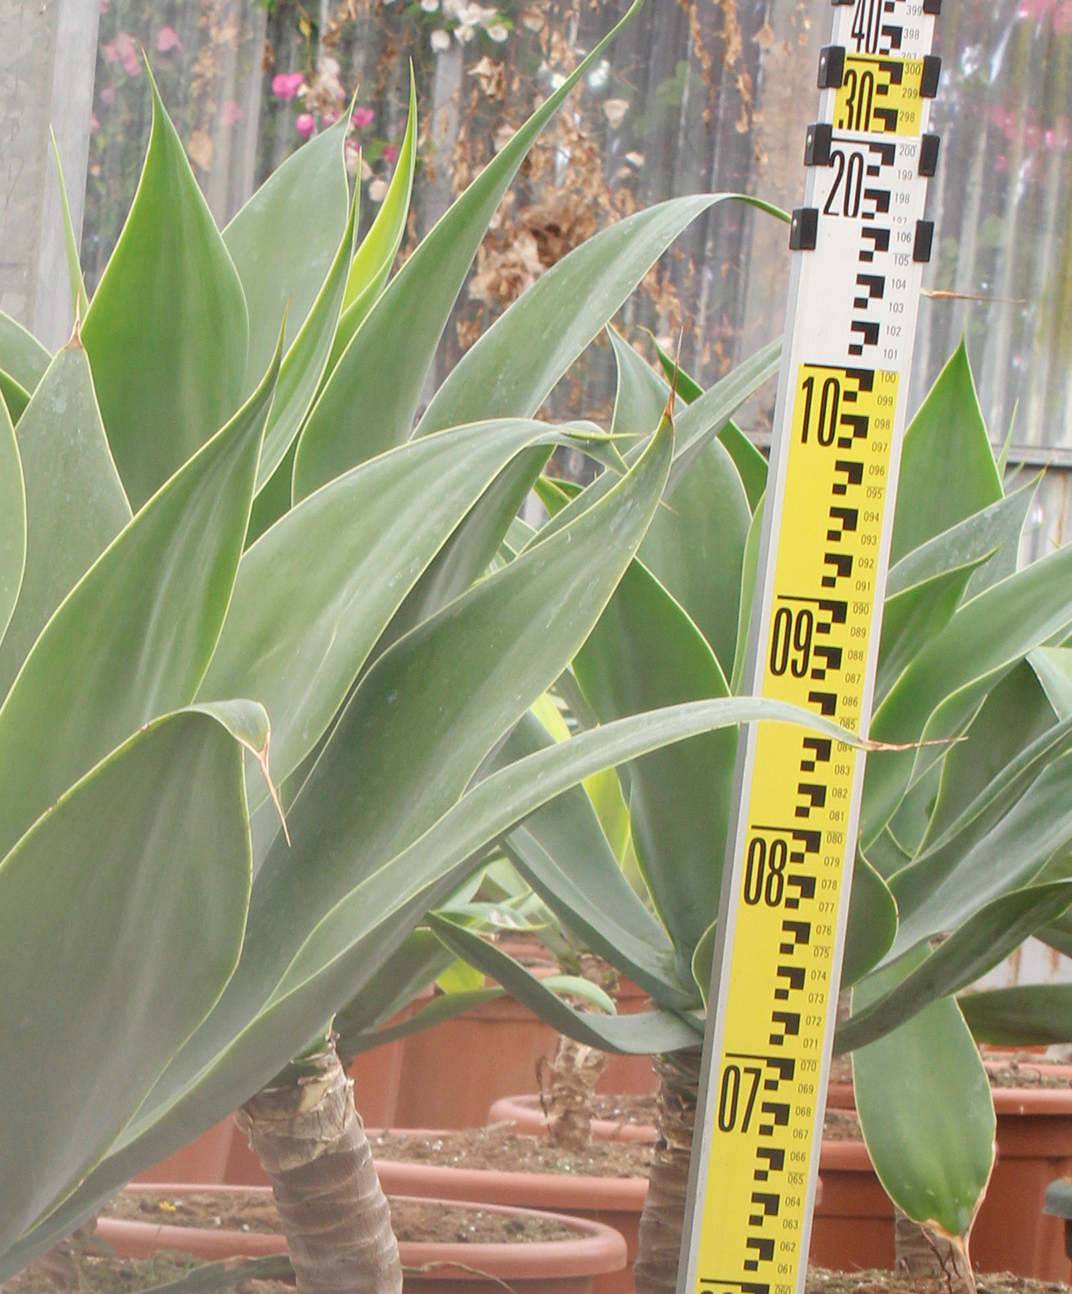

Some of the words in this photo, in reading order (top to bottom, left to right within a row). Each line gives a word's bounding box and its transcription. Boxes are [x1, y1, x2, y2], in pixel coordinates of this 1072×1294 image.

[905, 4, 923, 16] 399
[851, 0, 882, 54] 40
[903, 27, 921, 40] 398
[901, 87, 919, 99] 299
[838, 69, 874, 131] 30
[898, 109, 916, 123] 298
[897, 169, 913, 180] 199
[823, 150, 864, 218] 20
[895, 191, 911, 204] 198
[896, 231, 913, 243] 106
[891, 277, 907, 289] 104
[888, 301, 905, 313] 103
[886, 324, 903, 336] 102
[883, 347, 899, 360] 101
[876, 393, 894, 406] 099
[801, 376, 840, 446] 10
[873, 417, 891, 430] 098
[871, 440, 889, 453] 097
[868, 463, 886, 476] 096
[863, 510, 880, 522] 094
[860, 533, 878, 546] 093
[857, 556, 875, 568] 092
[855, 579, 871, 592] 091
[849, 625, 867, 638] 089
[770, 607, 813, 677] 09
[847, 649, 865, 661] 088
[844, 671, 862, 684] 087
[841, 695, 859, 707] 086
[833, 763, 851, 776] 083
[831, 786, 849, 800] 082
[828, 809, 845, 822] 081
[823, 855, 841, 867] 079
[744, 837, 788, 907] 08
[821, 878, 838, 890] 078
[818, 901, 835, 912] 077
[815, 923, 833, 936] 076
[810, 969, 827, 981] 074
[807, 991, 825, 1004] 073
[805, 1015, 823, 1026] 072
[802, 1037, 819, 1048] 071
[797, 1082, 815, 1094] 069
[718, 1065, 762, 1133] 07
[794, 1105, 812, 1117] 068
[792, 1127, 809, 1140] 067
[789, 1151, 807, 1162] 066
[784, 1195, 801, 1208] 064
[781, 1218, 799, 1230] 063
[779, 1240, 797, 1252] 062
[777, 1263, 793, 1274] 061
